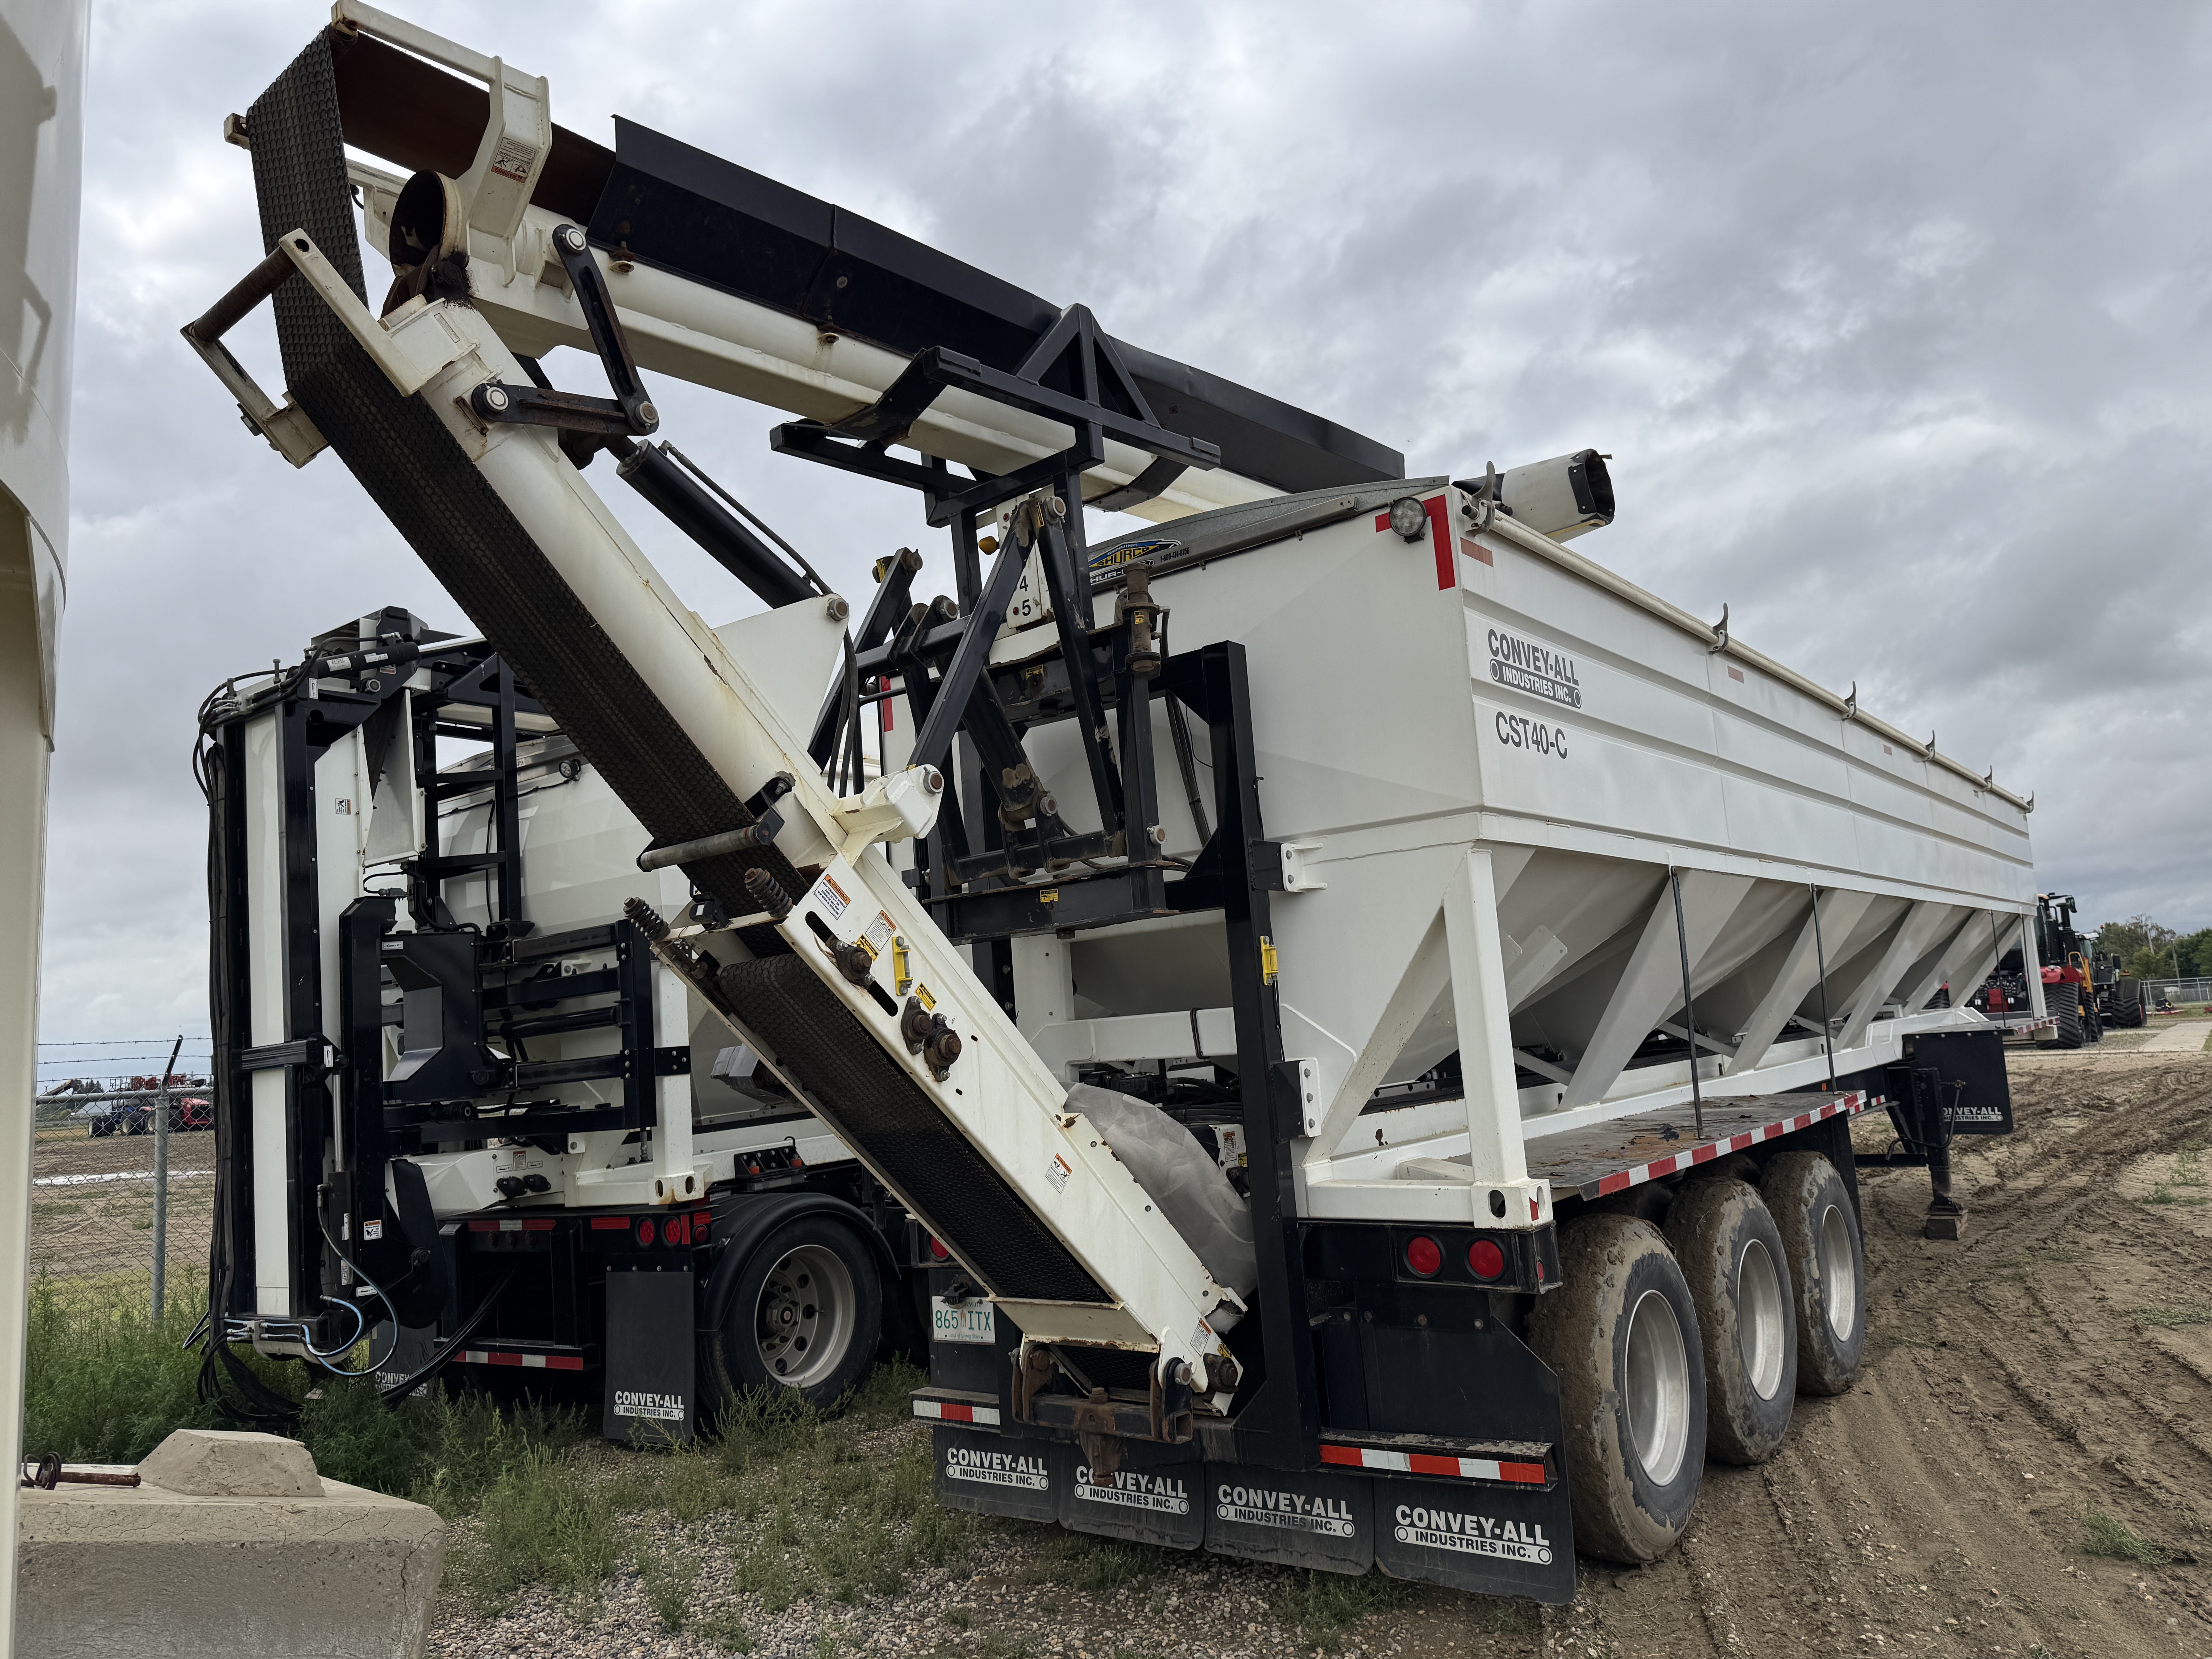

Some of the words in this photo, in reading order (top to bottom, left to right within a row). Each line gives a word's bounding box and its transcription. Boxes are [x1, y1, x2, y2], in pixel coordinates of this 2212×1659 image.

[495, 168, 516, 179] WARNING
[1020, 575, 1028, 592] 4
[1022, 599, 1031, 616] 5
[1488, 629, 1579, 686] CONVEY-ALL
[1503, 666, 1553, 697] INDUSTRIES
[1555, 686, 1571, 702] INC.
[1496, 711, 1567, 759] CST40-C
[831, 882, 847, 901] WARNING
[935, 1310, 958, 1329] 865
[968, 1311, 991, 1331] ITX
[615, 1391, 684, 1409] CONVEY-ALL
[623, 1407, 661, 1416] INDUSTRIES
[947, 1448, 1047, 1475] CONVEY-ALL
[960, 1468, 1013, 1483] INDUSTRIES
[1016, 1475, 1034, 1486] INC.
[1090, 1487, 1149, 1506] INDUSTRIES
[1152, 1497, 1173, 1510] INC.
[1218, 1484, 1353, 1520] CONVEY-ALL
[1235, 1508, 1307, 1528] INDUSTRIES
[1311, 1519, 1336, 1532] INC.
[1396, 1505, 1549, 1546] CONVEY-ALL
[1415, 1530, 1497, 1553] INDUSTRIES
[1502, 1544, 1531, 1558] INC.
